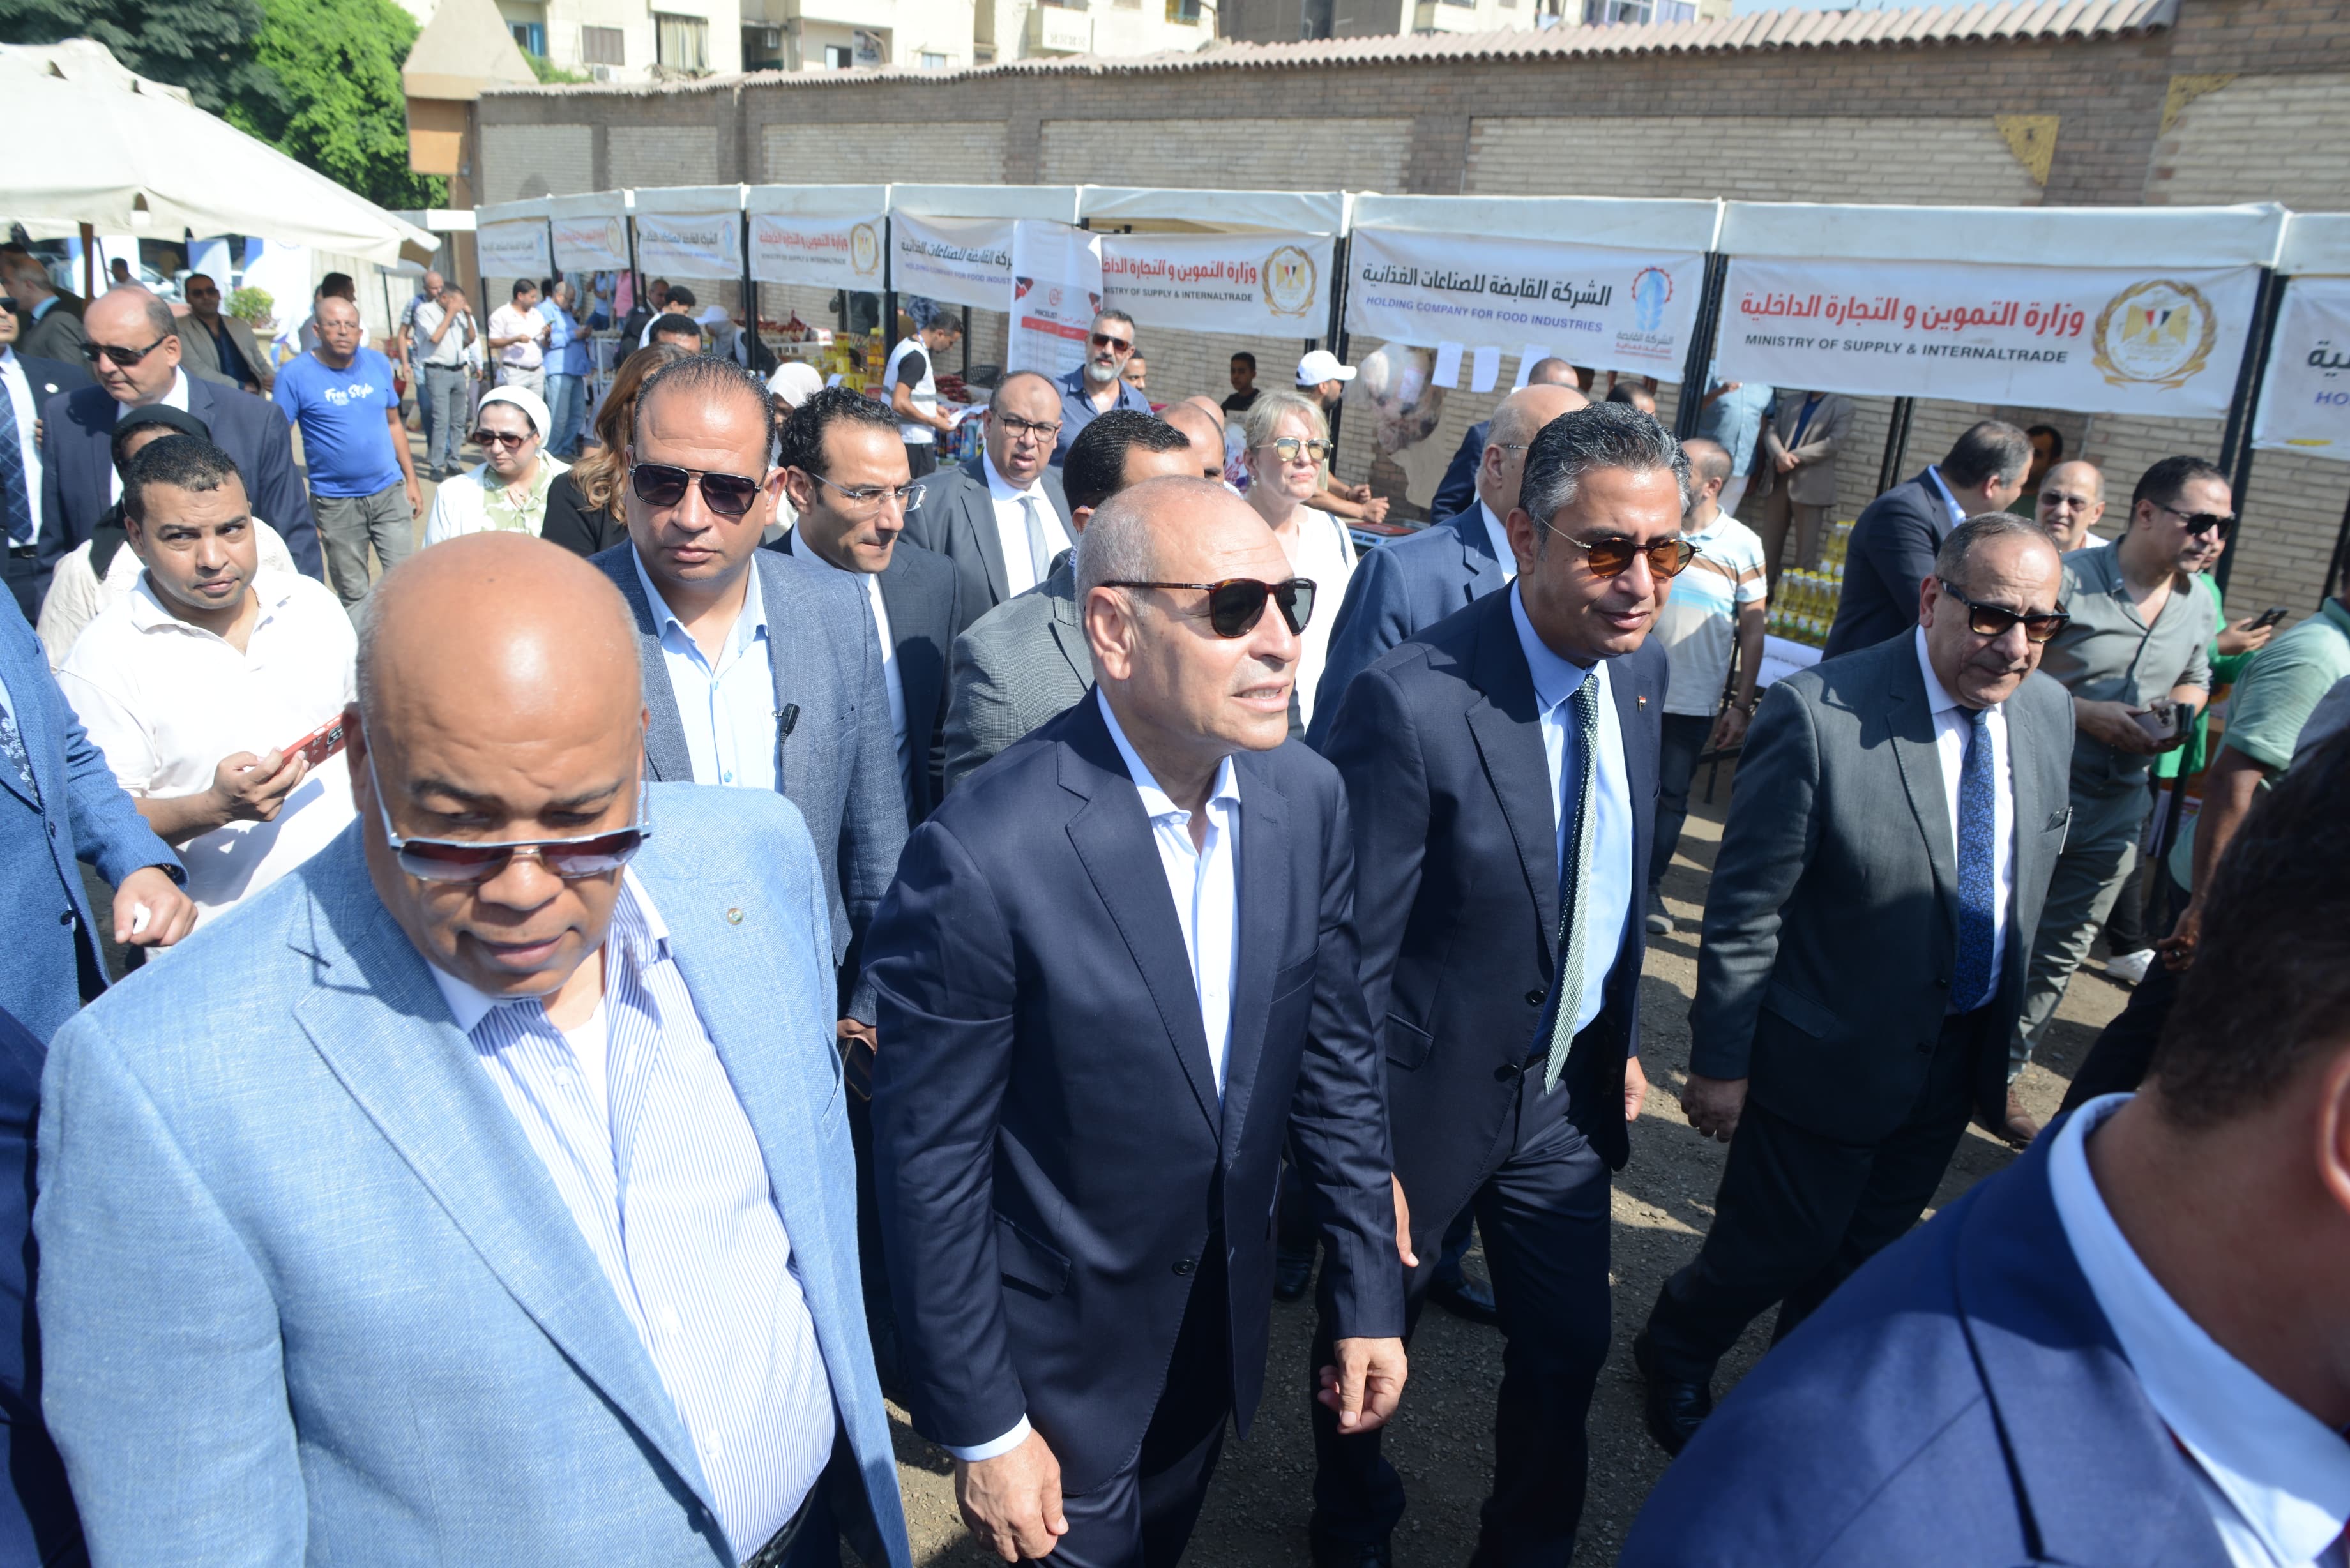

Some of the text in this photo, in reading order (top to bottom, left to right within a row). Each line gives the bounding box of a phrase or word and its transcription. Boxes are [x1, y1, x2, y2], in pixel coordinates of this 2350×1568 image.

[995, 252, 1012, 270] ركة
[1102, 257, 1257, 284] وزارة التموين و التجارة الداخ
[987, 275, 1012, 285] INDUST
[1363, 262, 1612, 309] الشركة القابضة للصناعات الغذائية
[1103, 285, 1254, 303] NISTRY OF SUPPLY & INTERNALTRADE
[1366, 296, 1603, 333] HOLDING COMPANY FOR FOOD INDUSTRIES
[1740, 292, 2085, 337] وزارة التموين و التجارة الداخلية
[1745, 334, 2068, 363] MINISTRY OF SUPPLY & INTERNALTRADE
[324, 388, 348, 402] Free
[2314, 391, 2350, 406] HO
